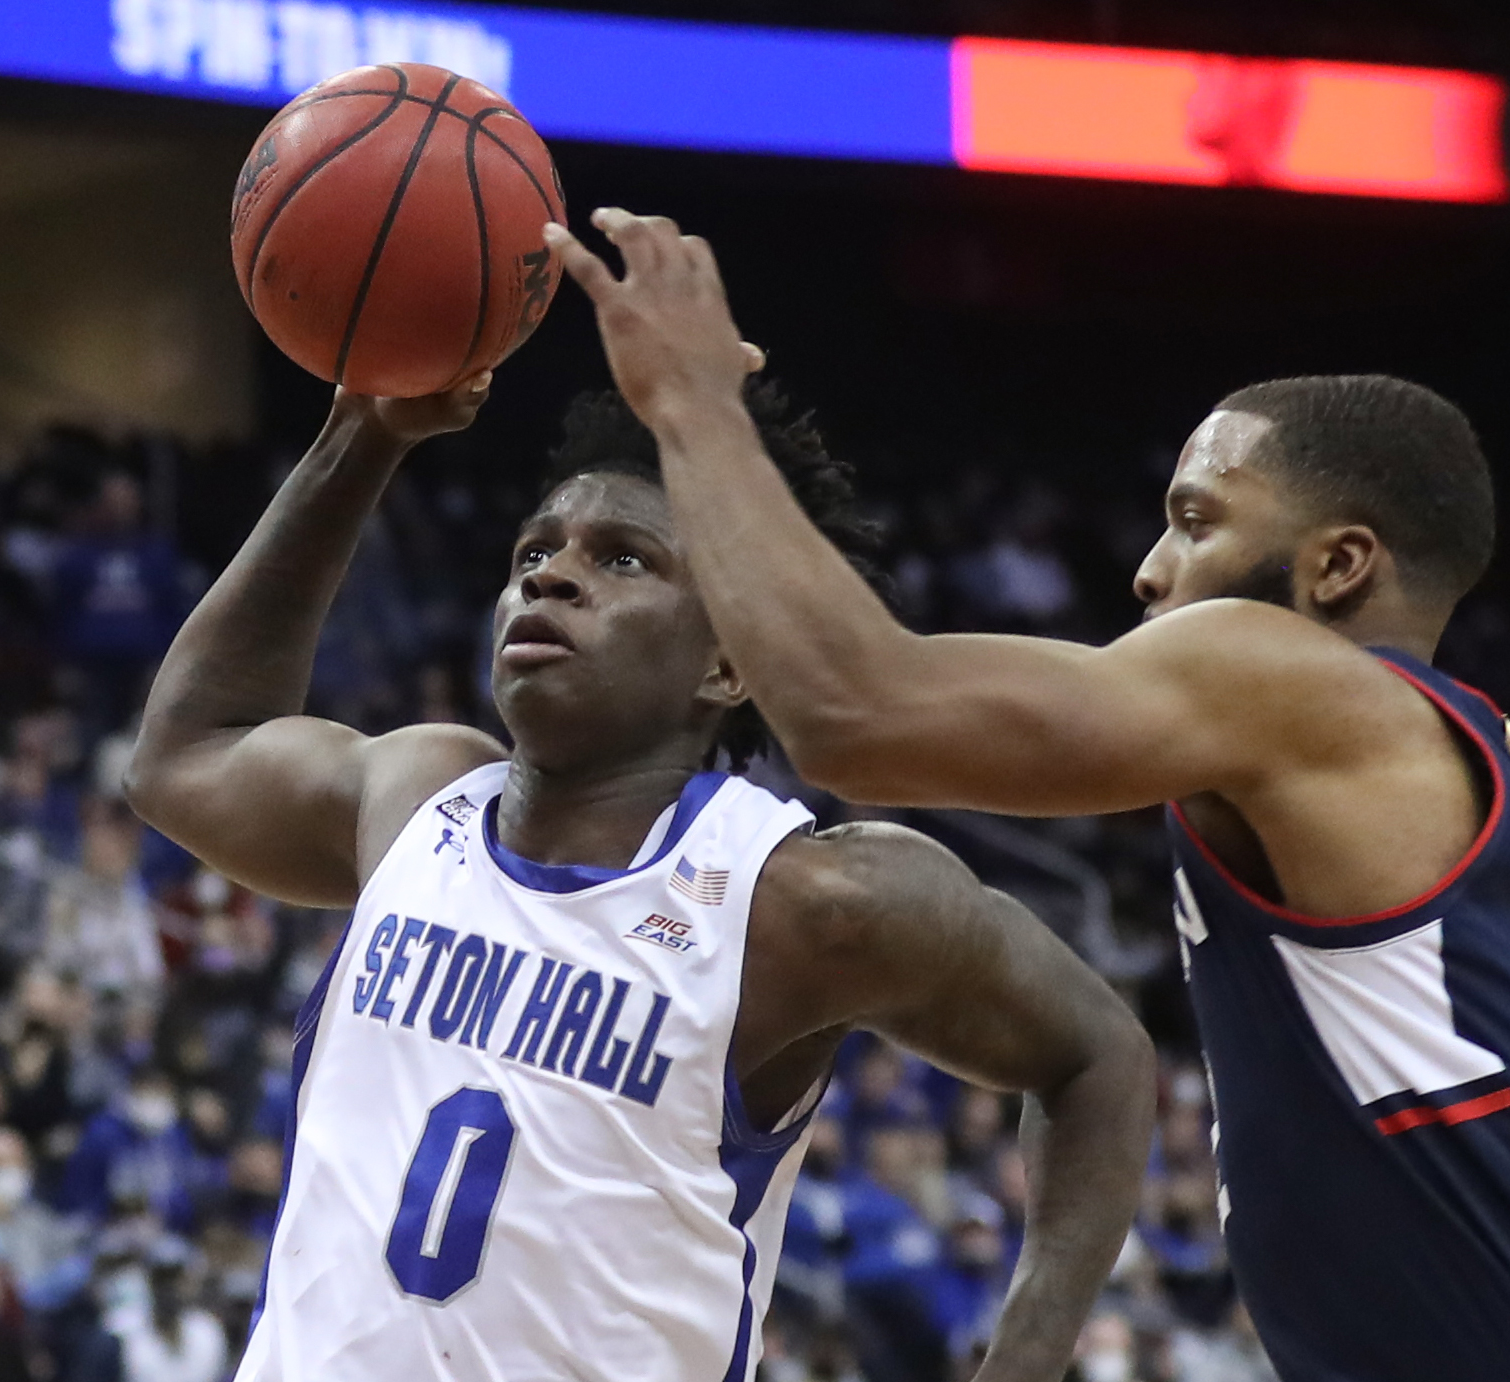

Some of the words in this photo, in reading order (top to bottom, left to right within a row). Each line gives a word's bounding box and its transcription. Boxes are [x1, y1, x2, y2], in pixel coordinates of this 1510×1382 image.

[631, 923, 698, 953] EAST
[643, 912, 693, 937] BIG
[352, 912, 531, 1052] SETON
[498, 956, 675, 1109] HALL
[384, 1084, 519, 1307] 0
